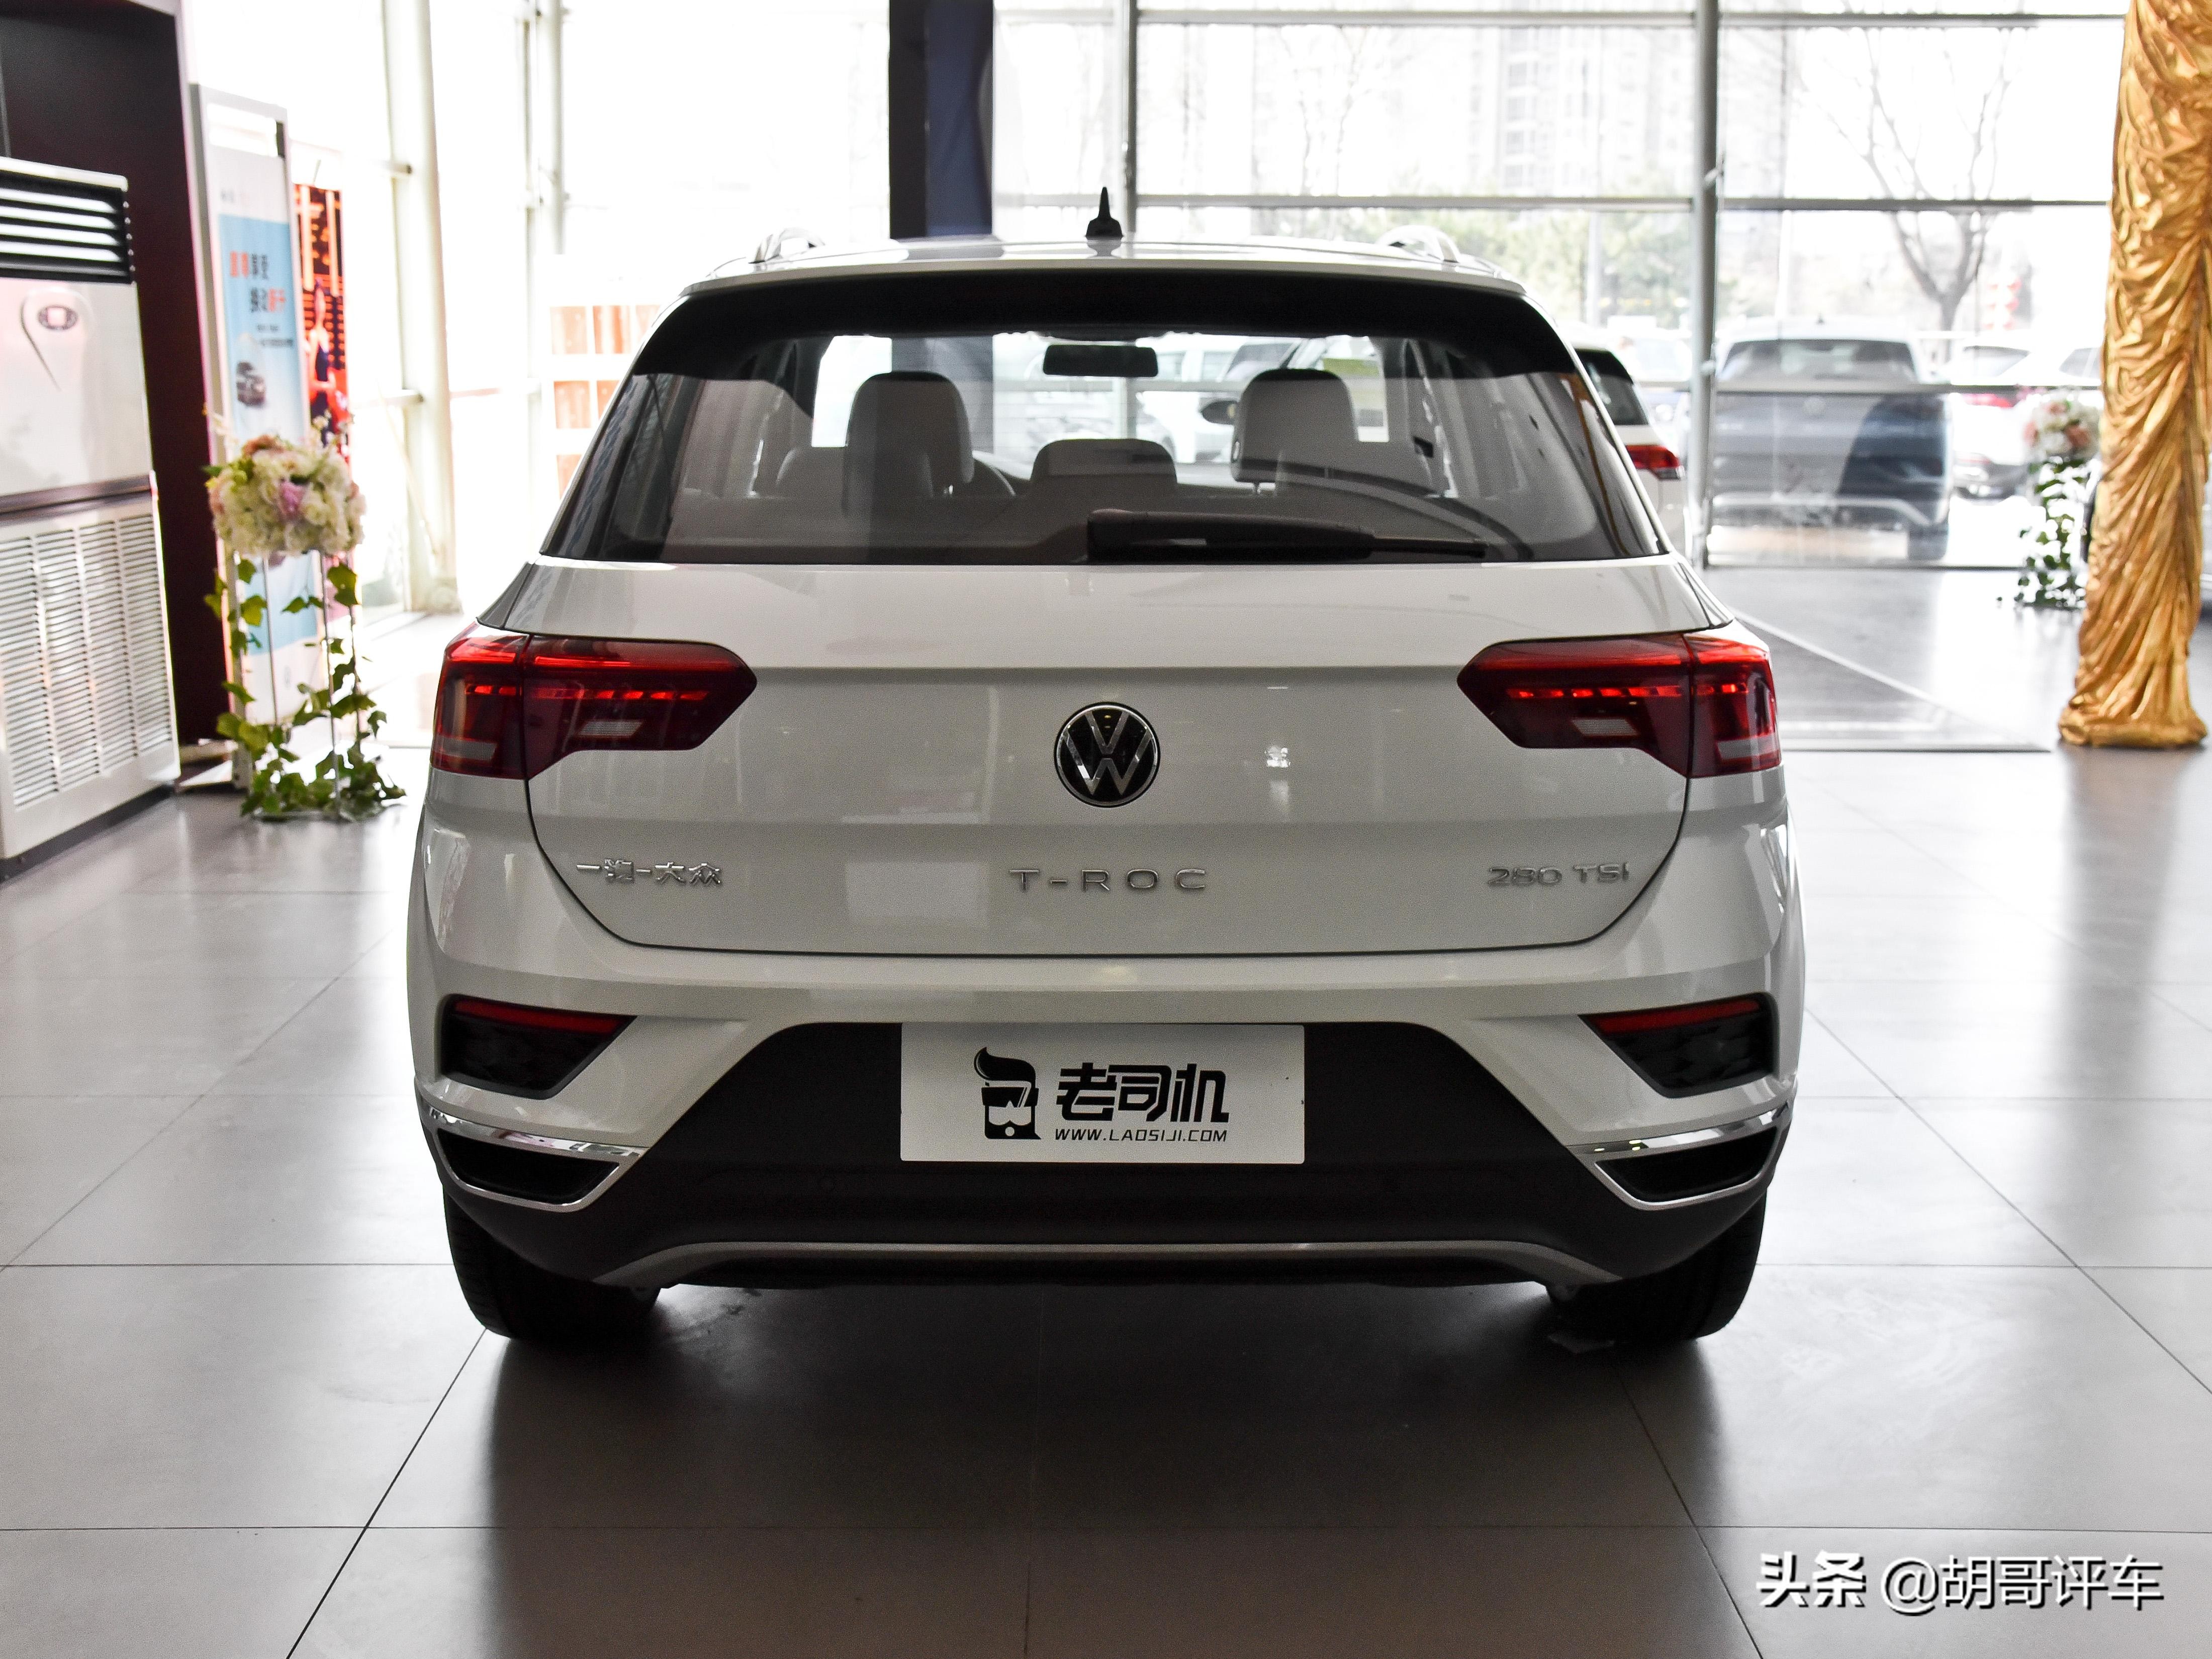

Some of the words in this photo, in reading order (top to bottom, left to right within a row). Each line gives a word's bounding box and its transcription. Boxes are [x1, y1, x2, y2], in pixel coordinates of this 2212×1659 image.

[1009, 868, 1206, 892] T-ROC
[1487, 866, 1562, 887] 280
[1056, 1062, 1230, 1123] 老司机
[1055, 1128, 1228, 1142] WWW.LAOSIJI.COM
